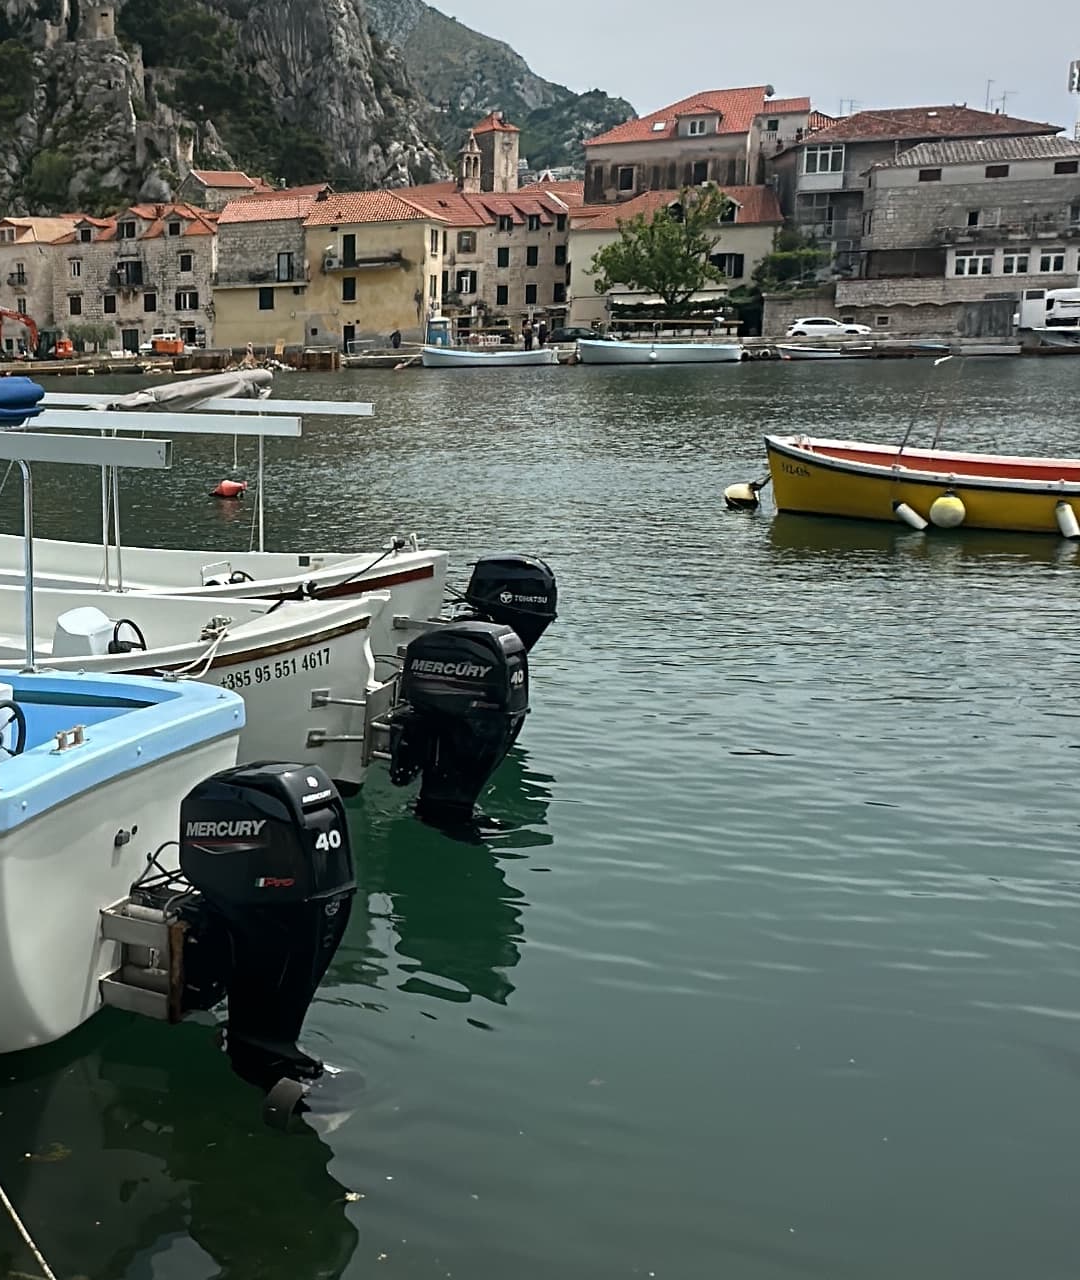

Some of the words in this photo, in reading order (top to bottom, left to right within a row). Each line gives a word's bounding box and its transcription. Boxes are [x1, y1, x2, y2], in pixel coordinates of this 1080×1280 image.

[220, 670, 251, 690] +385
[255, 665, 271, 683] 95
[275, 658, 297, 678] 551
[302, 647, 331, 671] 4617
[411, 659, 493, 677] MERCURY
[510, 669, 524, 685] 40
[186, 820, 267, 837] MERCURY
[315, 829, 341, 851] 40
